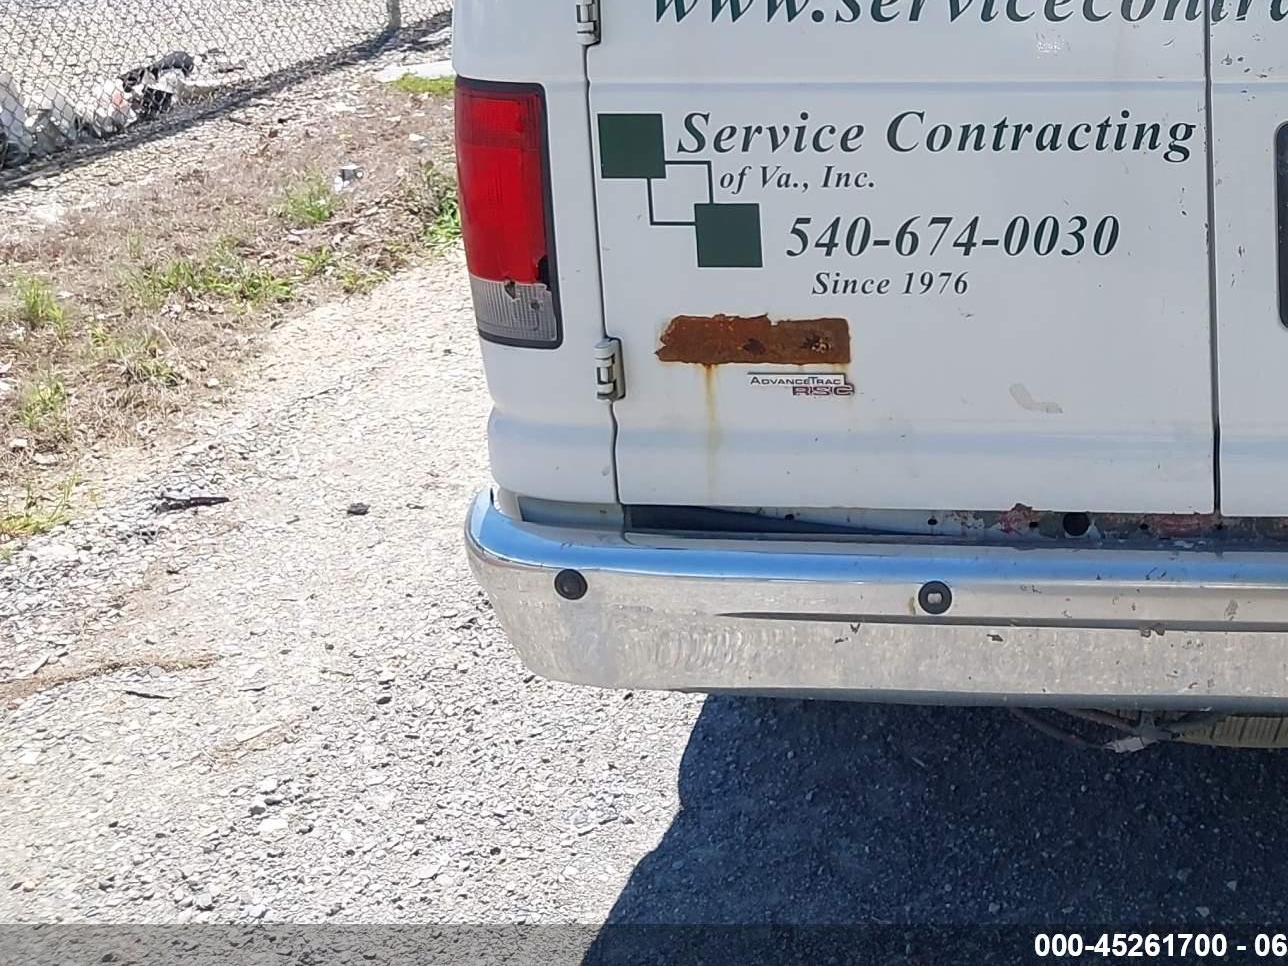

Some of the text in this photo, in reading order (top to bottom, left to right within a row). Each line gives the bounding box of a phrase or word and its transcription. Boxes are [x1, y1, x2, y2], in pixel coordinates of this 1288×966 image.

[677, 109, 1197, 163] Service Contracting
[719, 165, 874, 195] of Va., Inc.
[786, 215, 1120, 257] 540-674-0030
[811, 271, 969, 295] Since 1976
[792, 385, 854, 396] RSC
